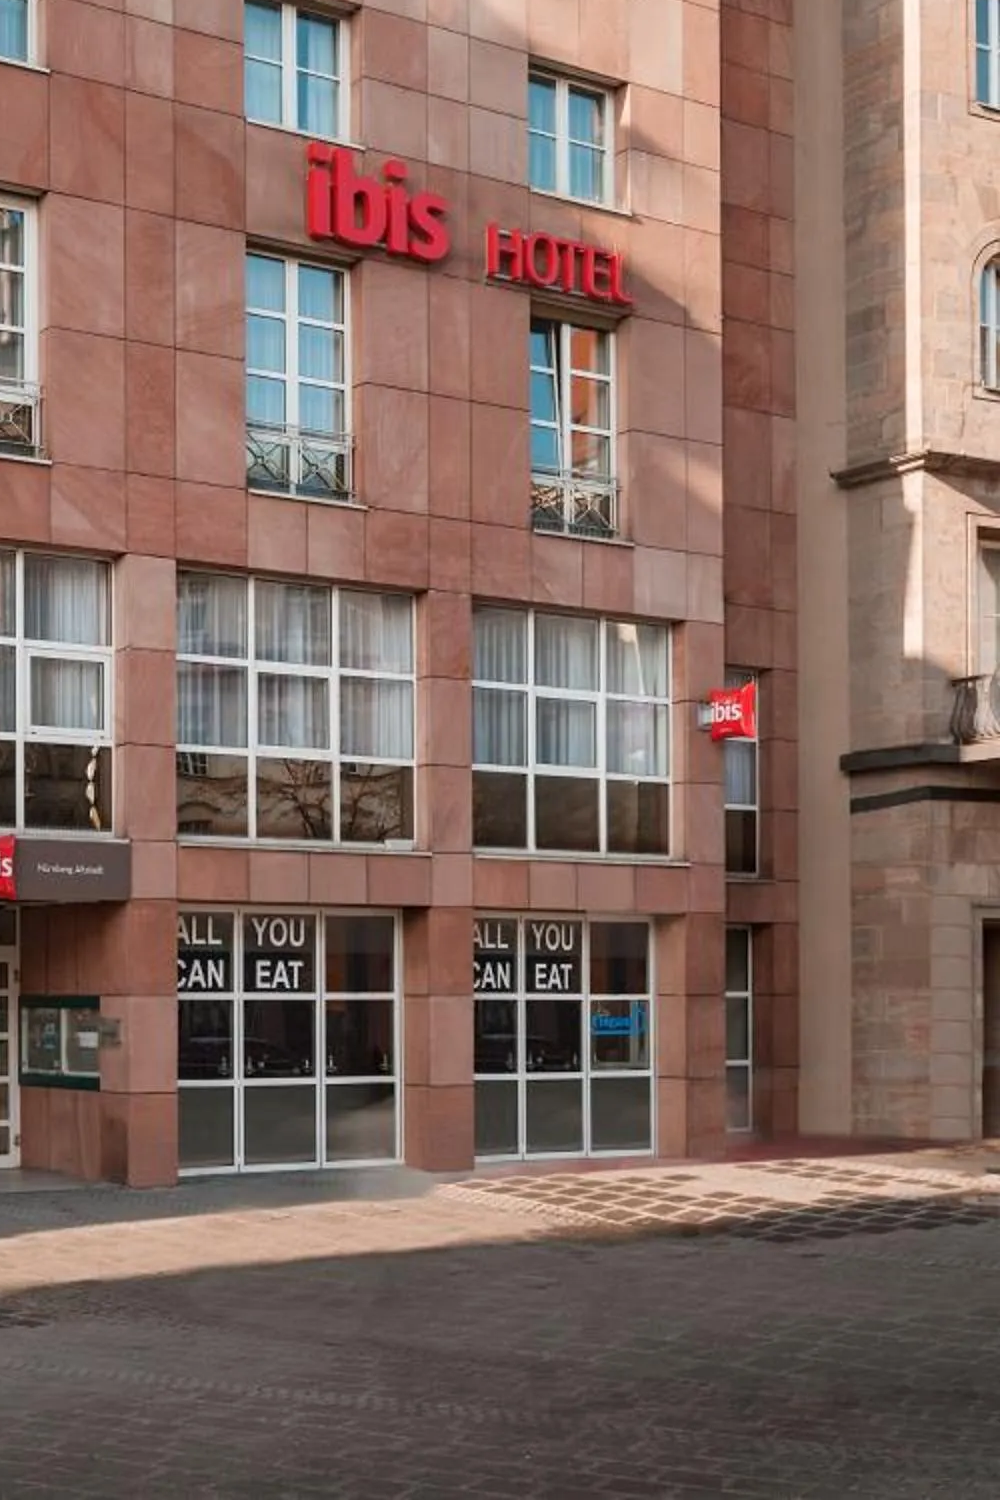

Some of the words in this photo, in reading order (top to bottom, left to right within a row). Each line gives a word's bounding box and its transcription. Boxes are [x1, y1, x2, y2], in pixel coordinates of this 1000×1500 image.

[306, 141, 449, 264] ibis
[486, 222, 633, 306] HOTEL
[711, 700, 743, 723] ibis
[178, 915, 222, 946] ALL
[251, 916, 306, 947] YOU
[531, 922, 574, 951] YOU
[255, 959, 304, 989] EAT
[535, 962, 573, 990] EAT
